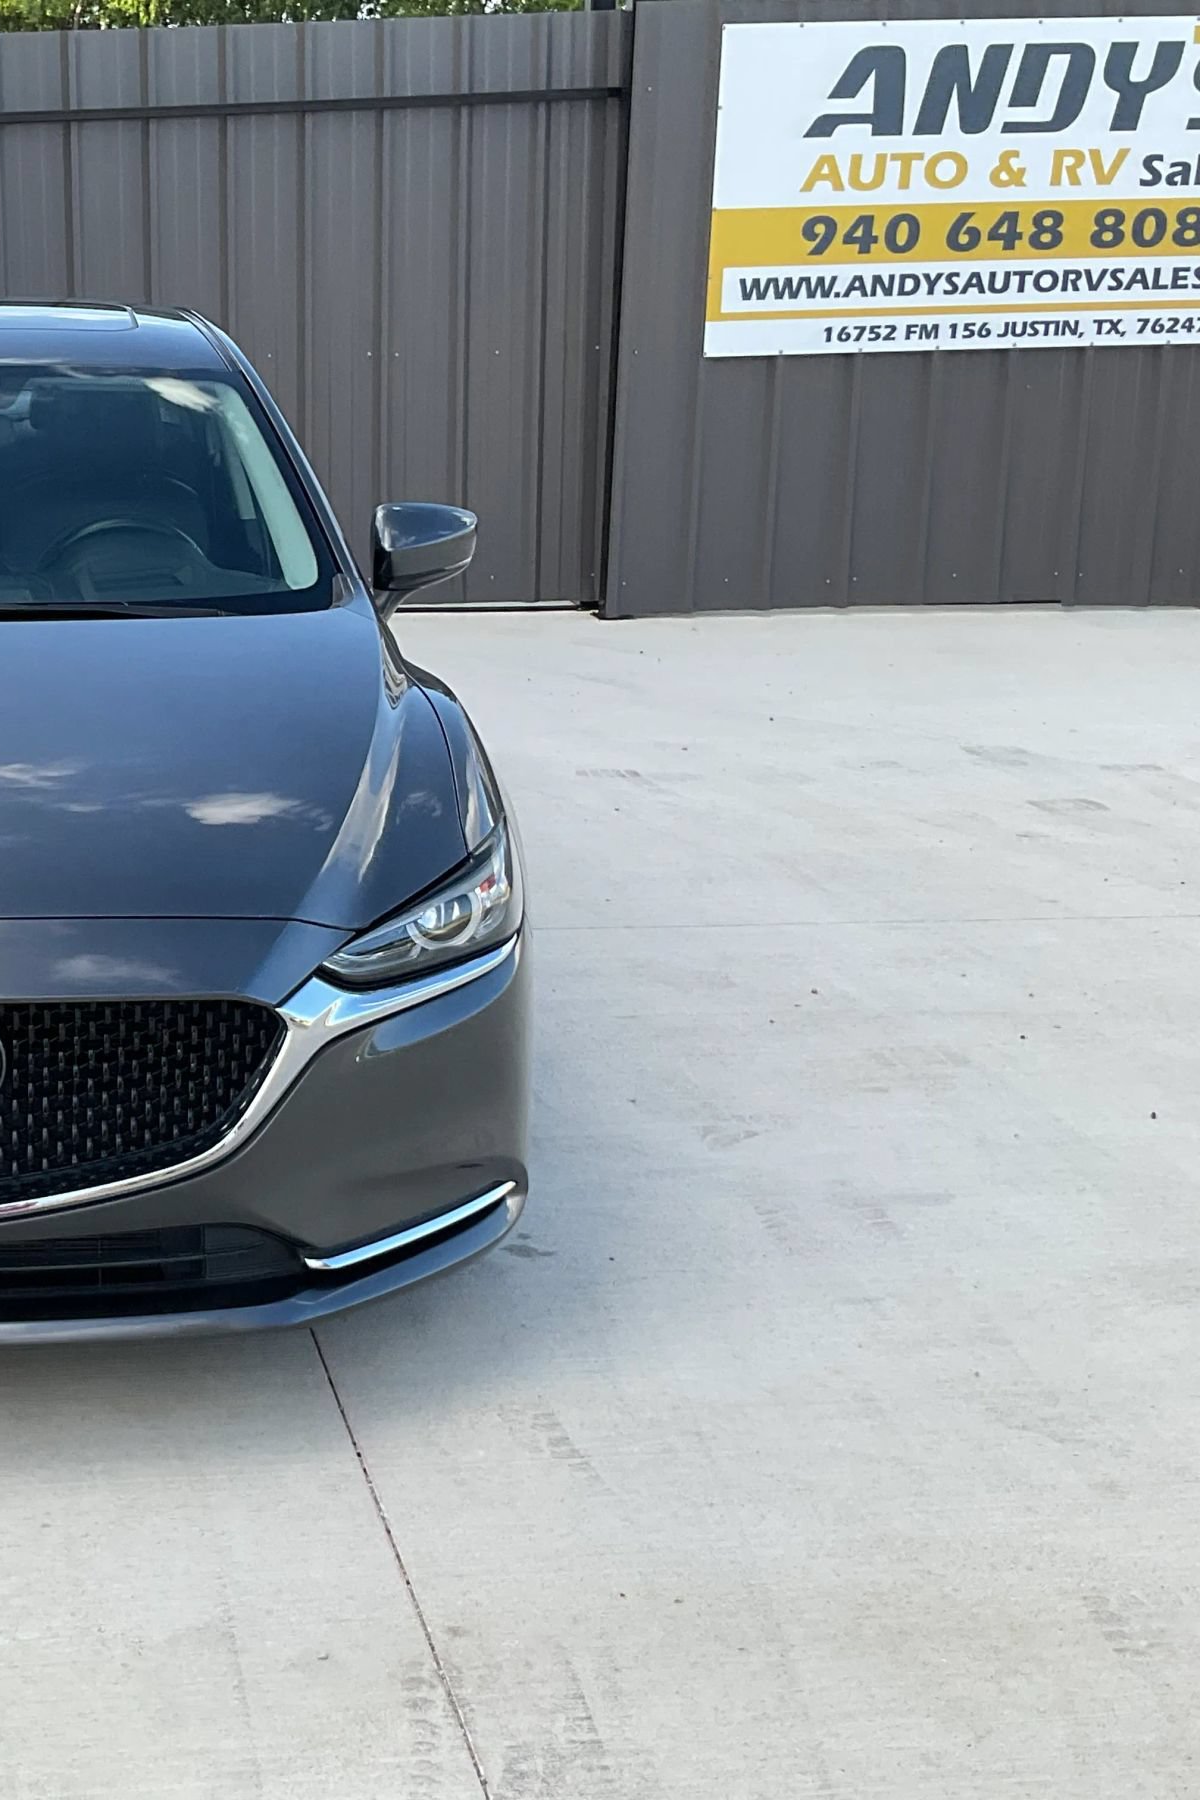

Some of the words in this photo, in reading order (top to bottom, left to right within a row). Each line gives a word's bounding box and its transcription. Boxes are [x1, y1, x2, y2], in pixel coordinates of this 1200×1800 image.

[802, 41, 1200, 138] ANDY
[800, 151, 968, 192] AUTO
[989, 150, 1027, 187] &
[1050, 148, 1131, 187] RV
[801, 213, 921, 256] 940
[946, 209, 1064, 251] 648
[1090, 206, 1200, 249] 808
[823, 325, 897, 343] 16752
[904, 323, 940, 341] FM
[948, 322, 992, 339] 156
[997, 319, 1085, 339] JUSTIN,
[1093, 318, 1126, 337] TX,
